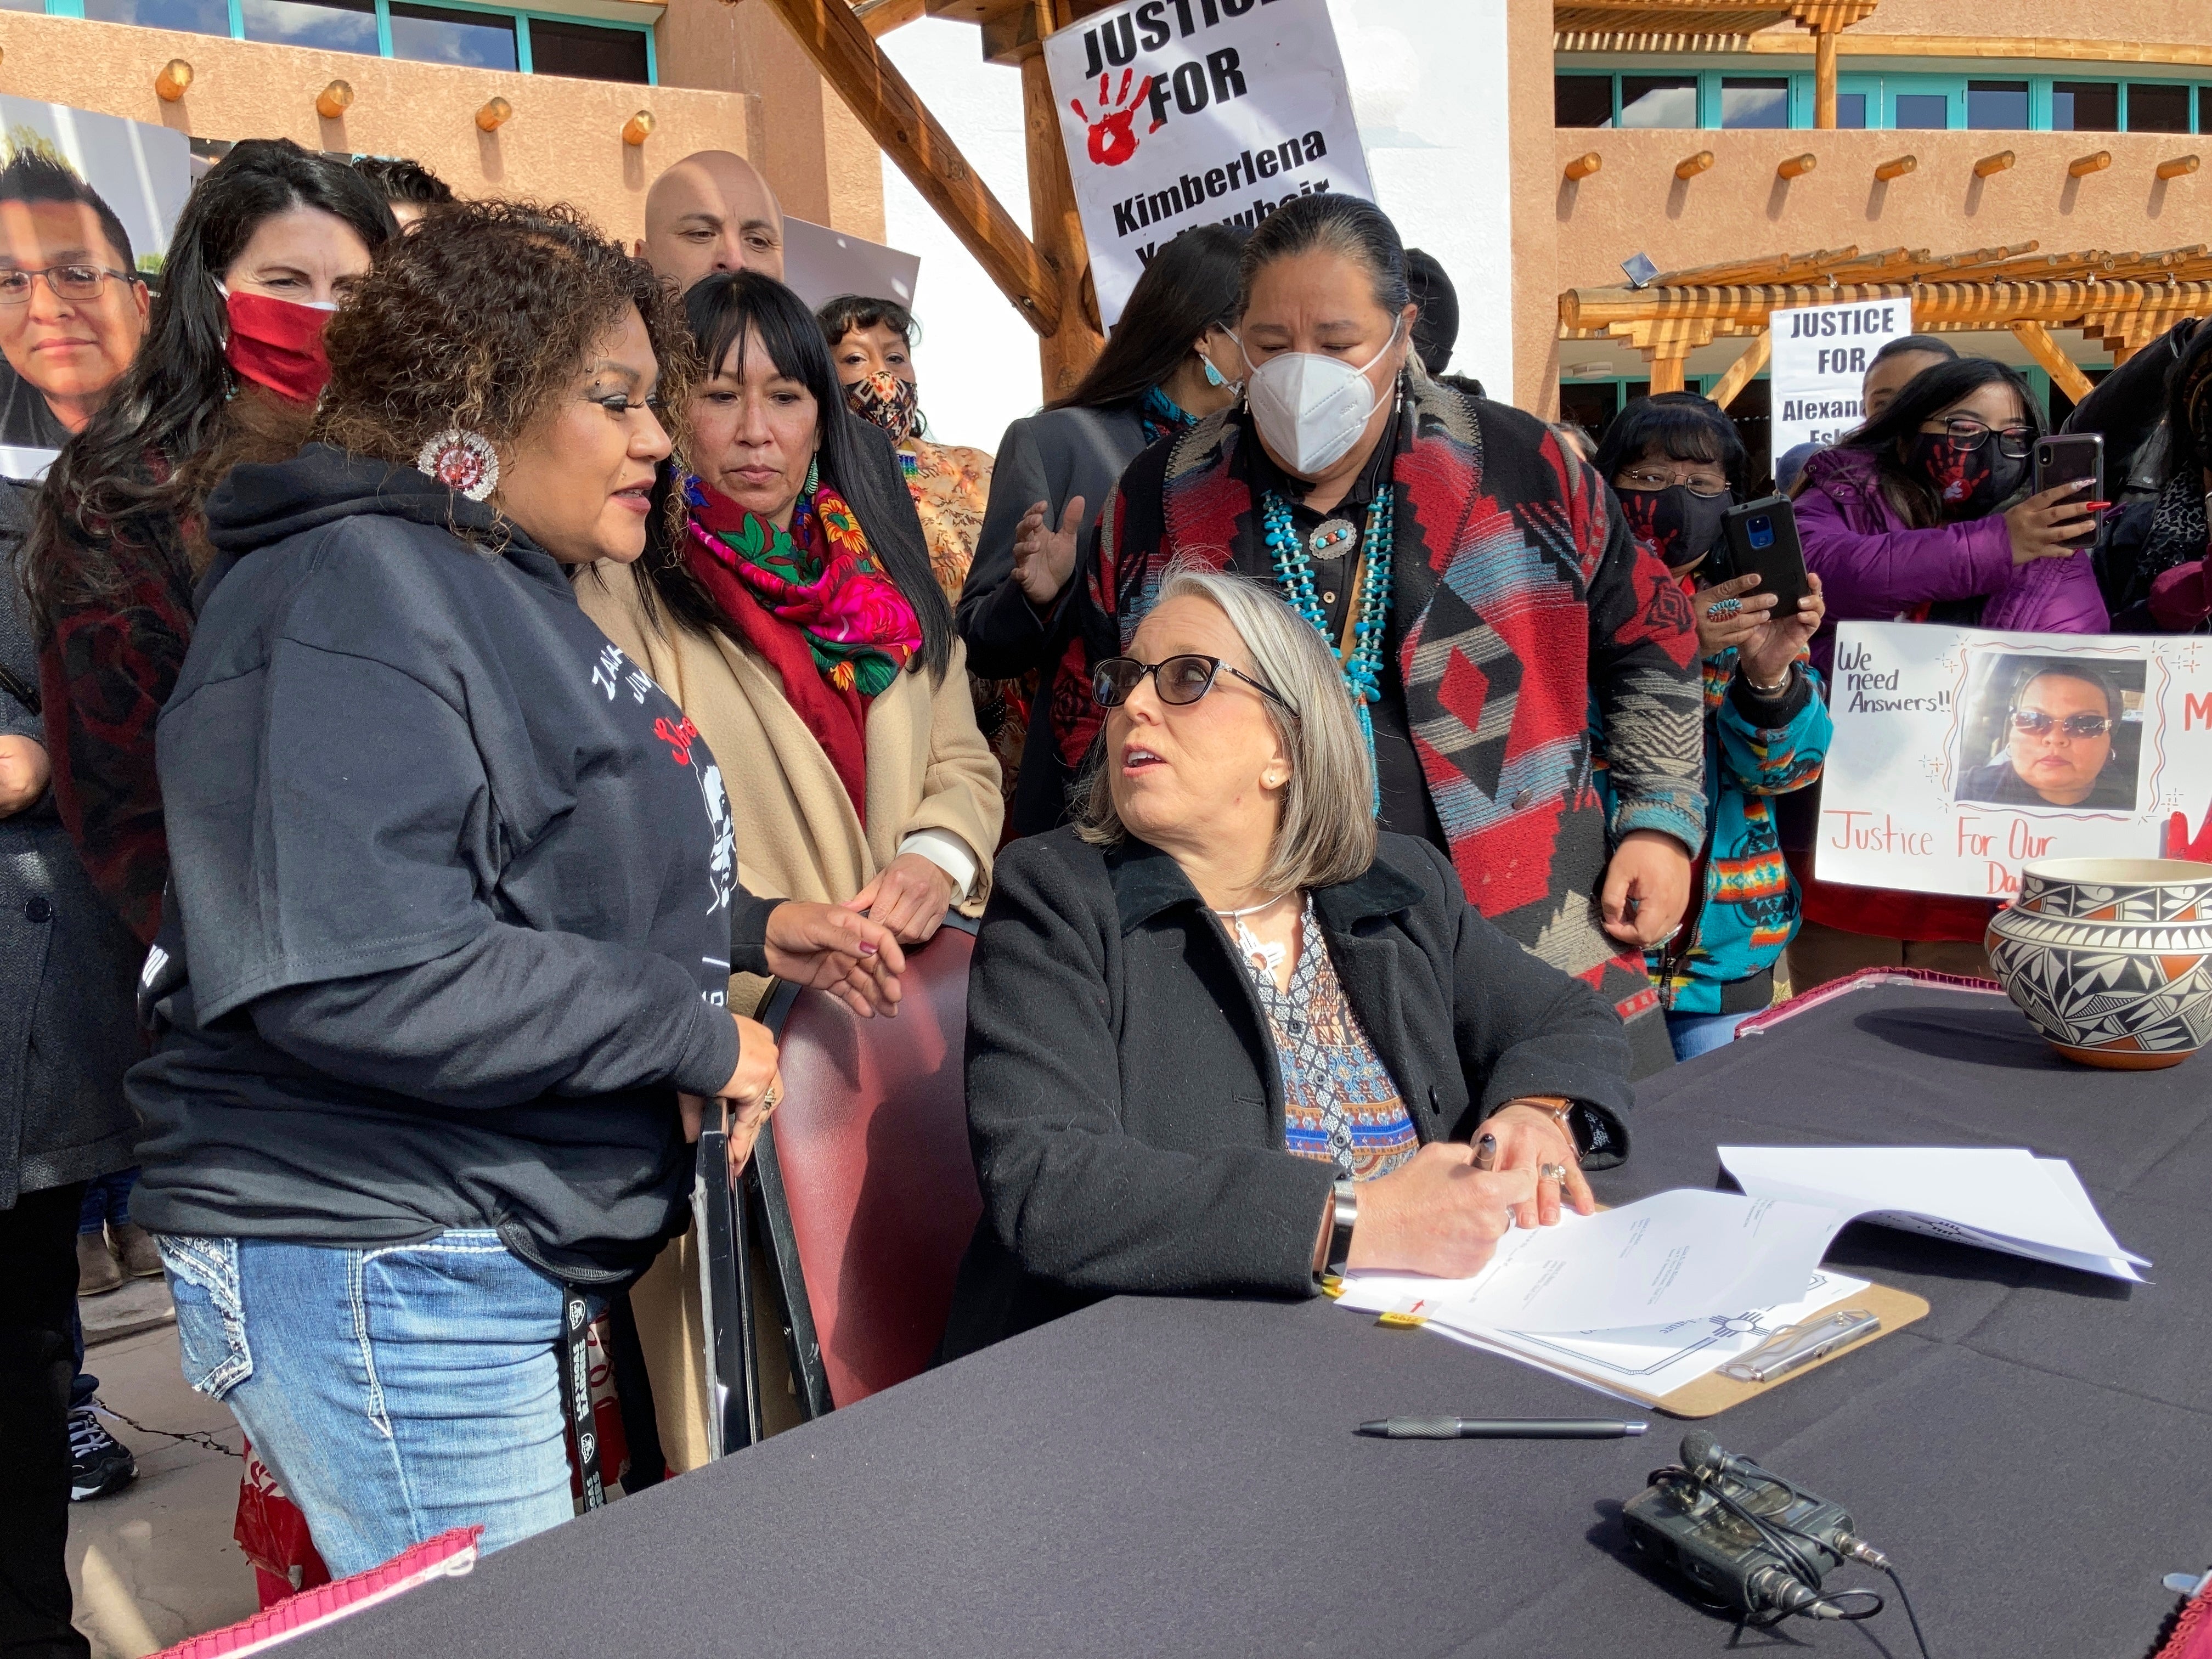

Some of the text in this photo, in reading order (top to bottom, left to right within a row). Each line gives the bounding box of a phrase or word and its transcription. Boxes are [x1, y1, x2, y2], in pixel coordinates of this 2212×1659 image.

[1148, 47, 1247, 125] FOR
[1113, 130, 1327, 238] Kimberlena
[1791, 307, 1894, 338] JUSTICE
[1818, 348, 1865, 375] FOR
[1838, 641, 1872, 671] We
[1848, 669, 1899, 691] need
[1848, 690, 1951, 713] Answers!!
[1823, 809, 2058, 860] Justice For Our
[1983, 860, 2019, 894] Da
[579, 1338, 590, 1417] RAIDERS
